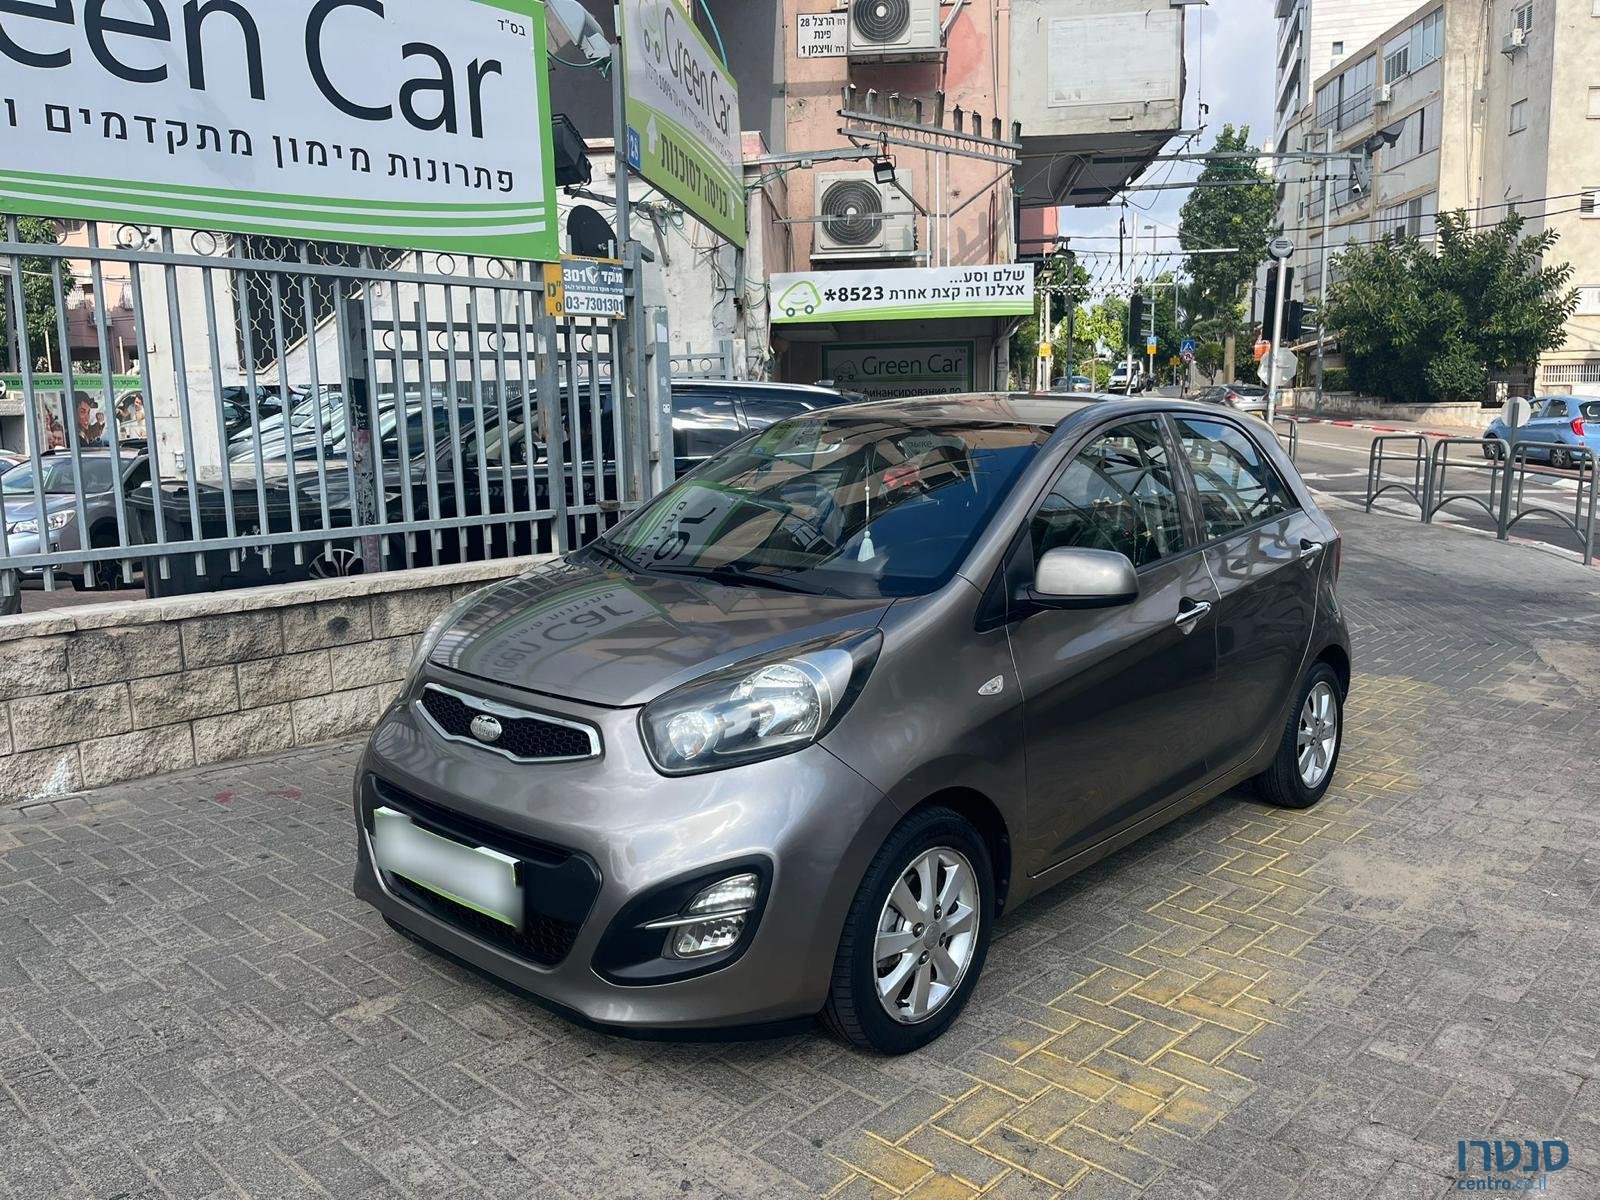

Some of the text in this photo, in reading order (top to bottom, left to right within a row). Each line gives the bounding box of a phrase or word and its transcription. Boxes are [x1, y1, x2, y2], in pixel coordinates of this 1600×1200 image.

[497, 19, 527, 37] בס"ד
[800, 18, 810, 27] 28
[812, 16, 835, 27] הרצל
[813, 30, 832, 40] פינת
[801, 45, 806, 54] 1
[304, 0, 503, 139] Car
[664, 7, 710, 117] Green
[710, 70, 731, 138] Car
[44, 103, 254, 158] מתקדמים
[272, 134, 371, 174] מימון
[387, 153, 514, 193] פתרונות
[660, 133, 728, 218] כניסה לסוכנות
[563, 268, 587, 283] 301
[949, 268, 1025, 284] שלם וסע...
[889, 289, 926, 300] אחרת
[931, 286, 961, 301] קצת
[965, 286, 981, 297] זה
[986, 284, 1025, 297] אצלנו
[565, 295, 624, 313] 03-7301301
[862, 354, 963, 376] Green Car
